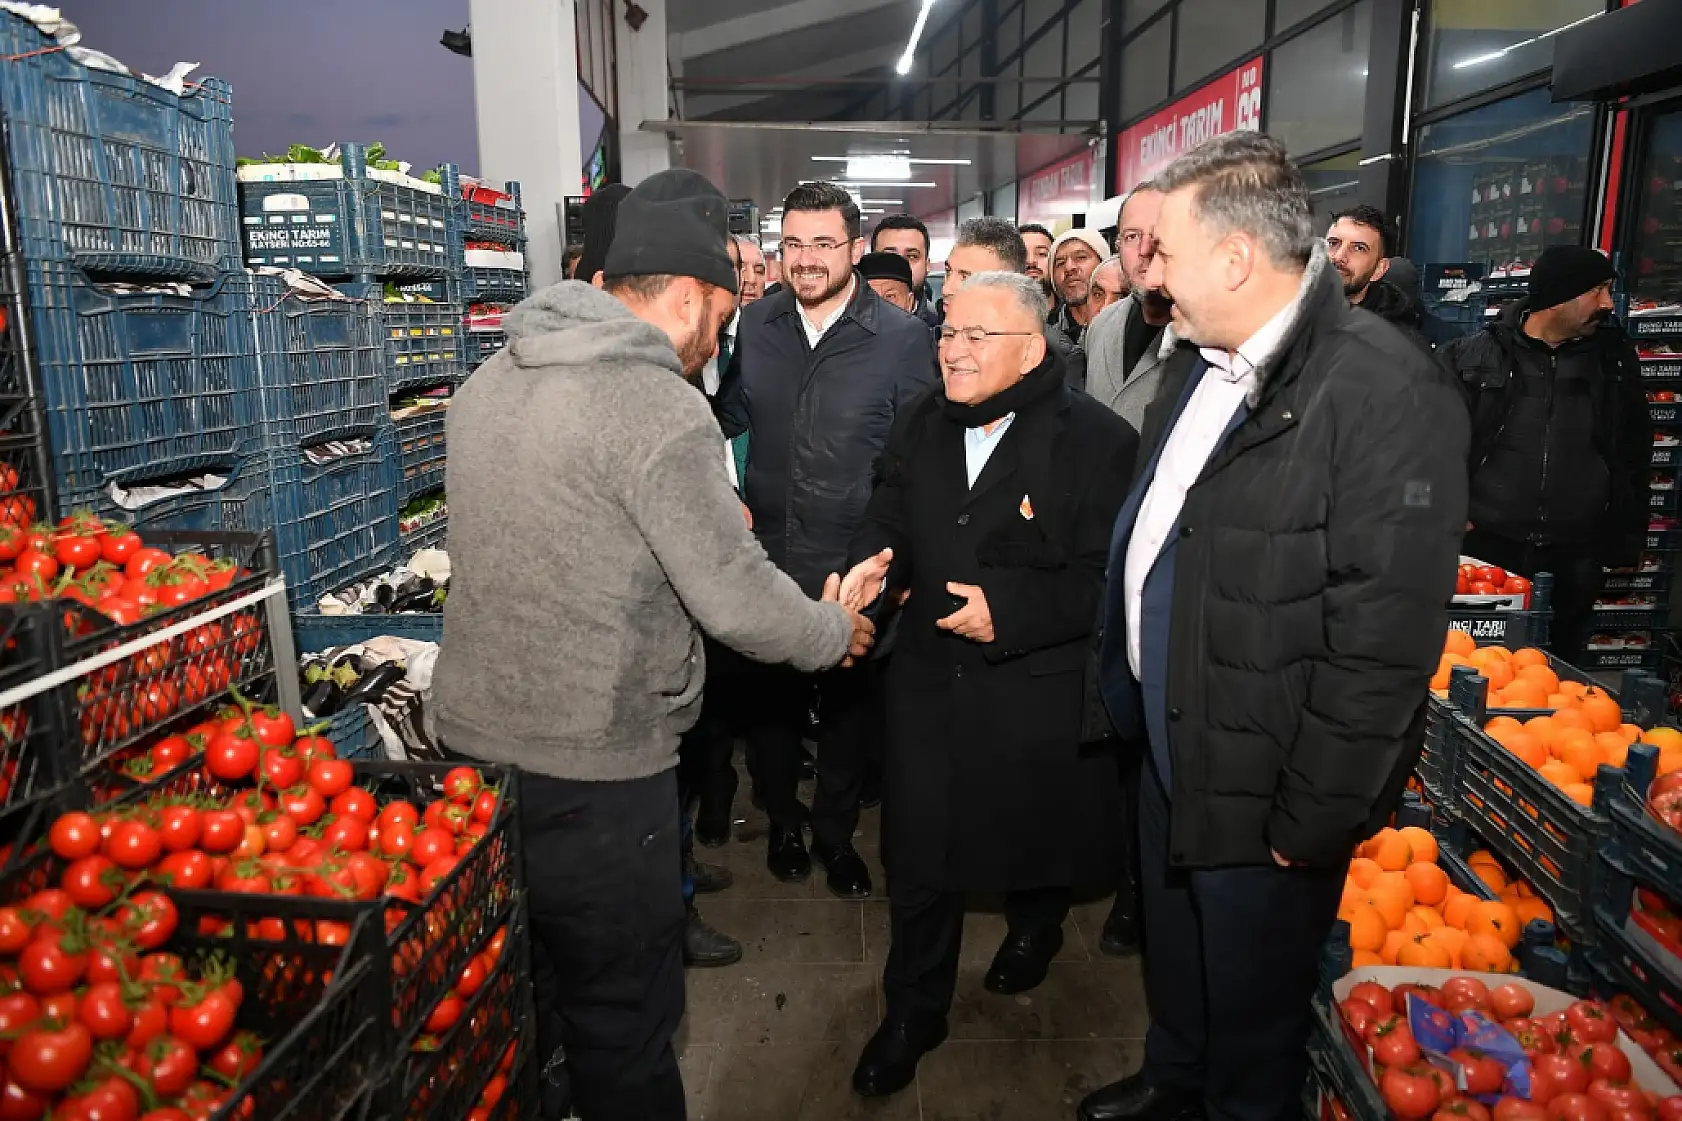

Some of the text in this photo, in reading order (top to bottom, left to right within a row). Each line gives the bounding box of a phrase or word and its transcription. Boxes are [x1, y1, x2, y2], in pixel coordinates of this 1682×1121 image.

[1241, 66, 1257, 88] NO
[1180, 98, 1224, 149] TARIM
[291, 229, 331, 240] TARIM
